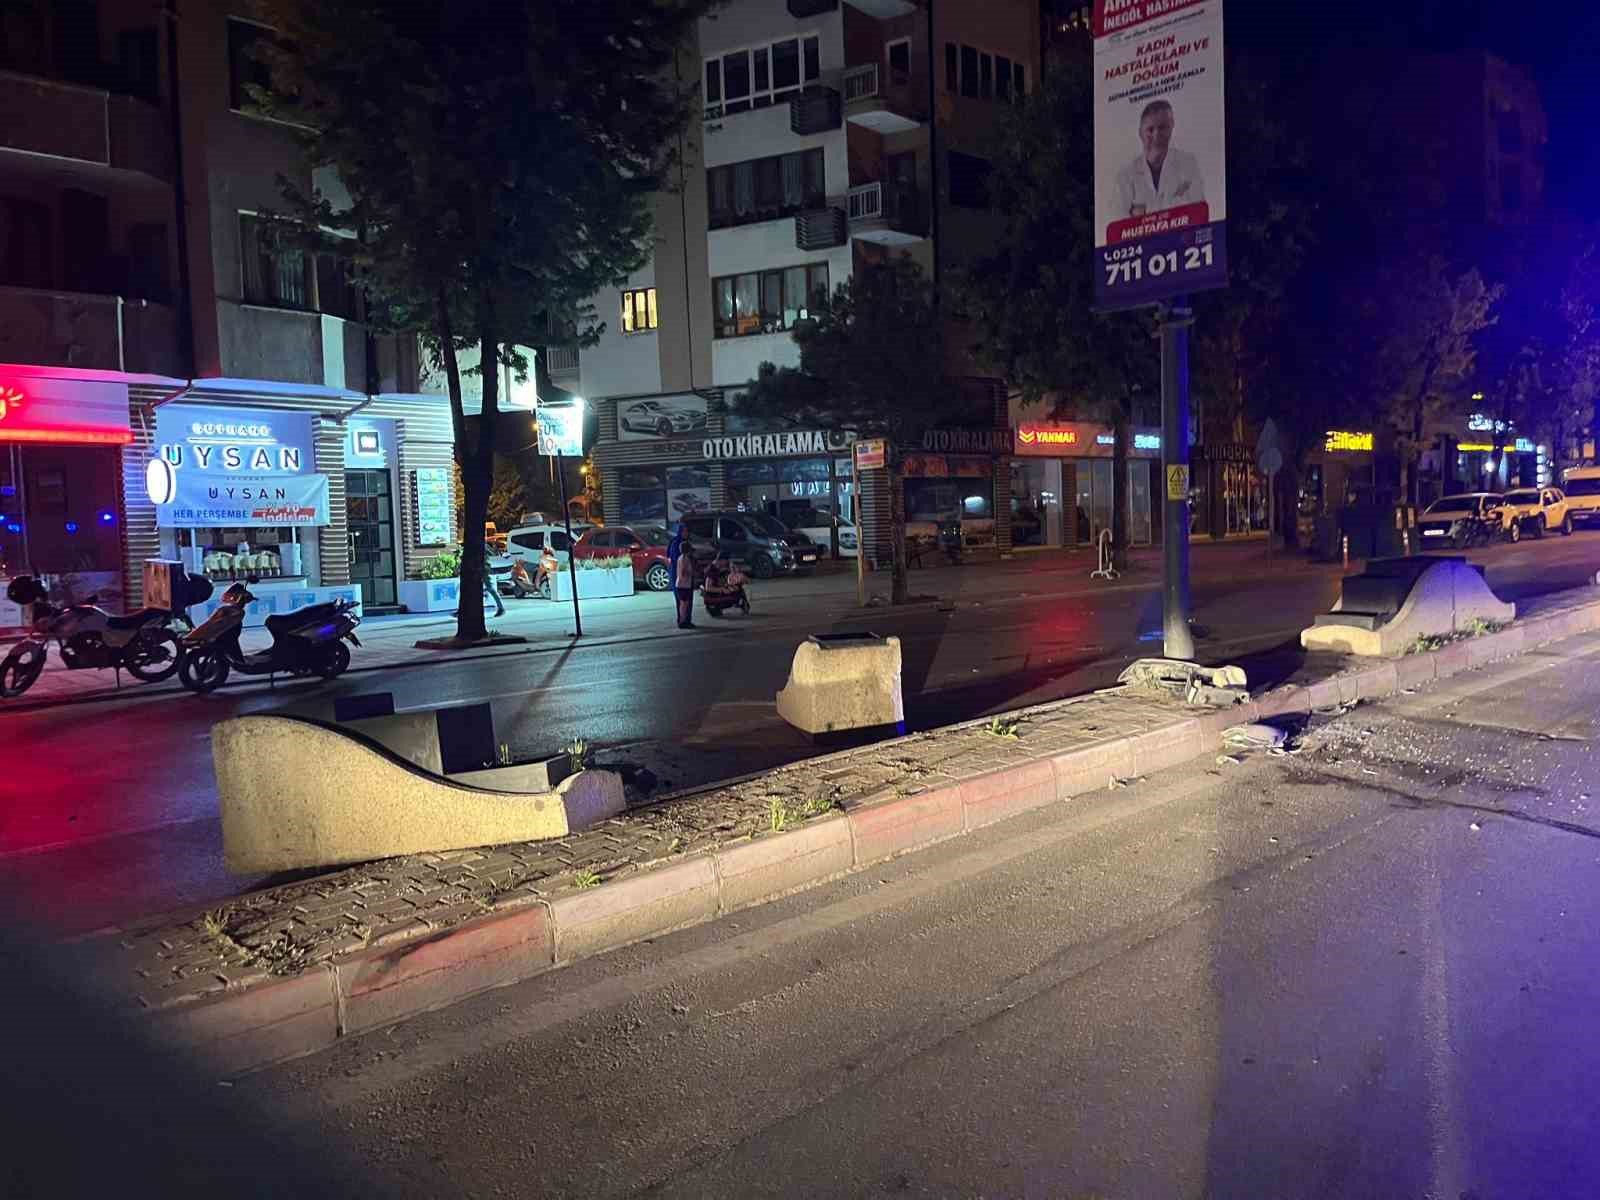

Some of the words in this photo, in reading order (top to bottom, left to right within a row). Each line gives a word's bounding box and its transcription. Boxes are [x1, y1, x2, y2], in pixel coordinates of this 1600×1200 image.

[1135, 34, 1176, 56] KADIN
[1105, 43, 1191, 80] HASTALIKLARI
[1193, 37, 1209, 51] VE
[1132, 61, 1179, 84] DOĞUM
[1121, 220, 1169, 240] MUSTAFA
[1113, 244, 1143, 262] 0224
[1105, 256, 1142, 286] 711
[1148, 250, 1177, 276] 01
[1184, 243, 1213, 270] 21
[702, 438, 734, 459] OTO
[736, 431, 825, 456] KİRALAMA
[1036, 432, 1075, 443] YANMAR
[165, 446, 299, 469] UYSAN
[208, 486, 286, 500] UYSAN
[173, 509, 193, 518] HER
